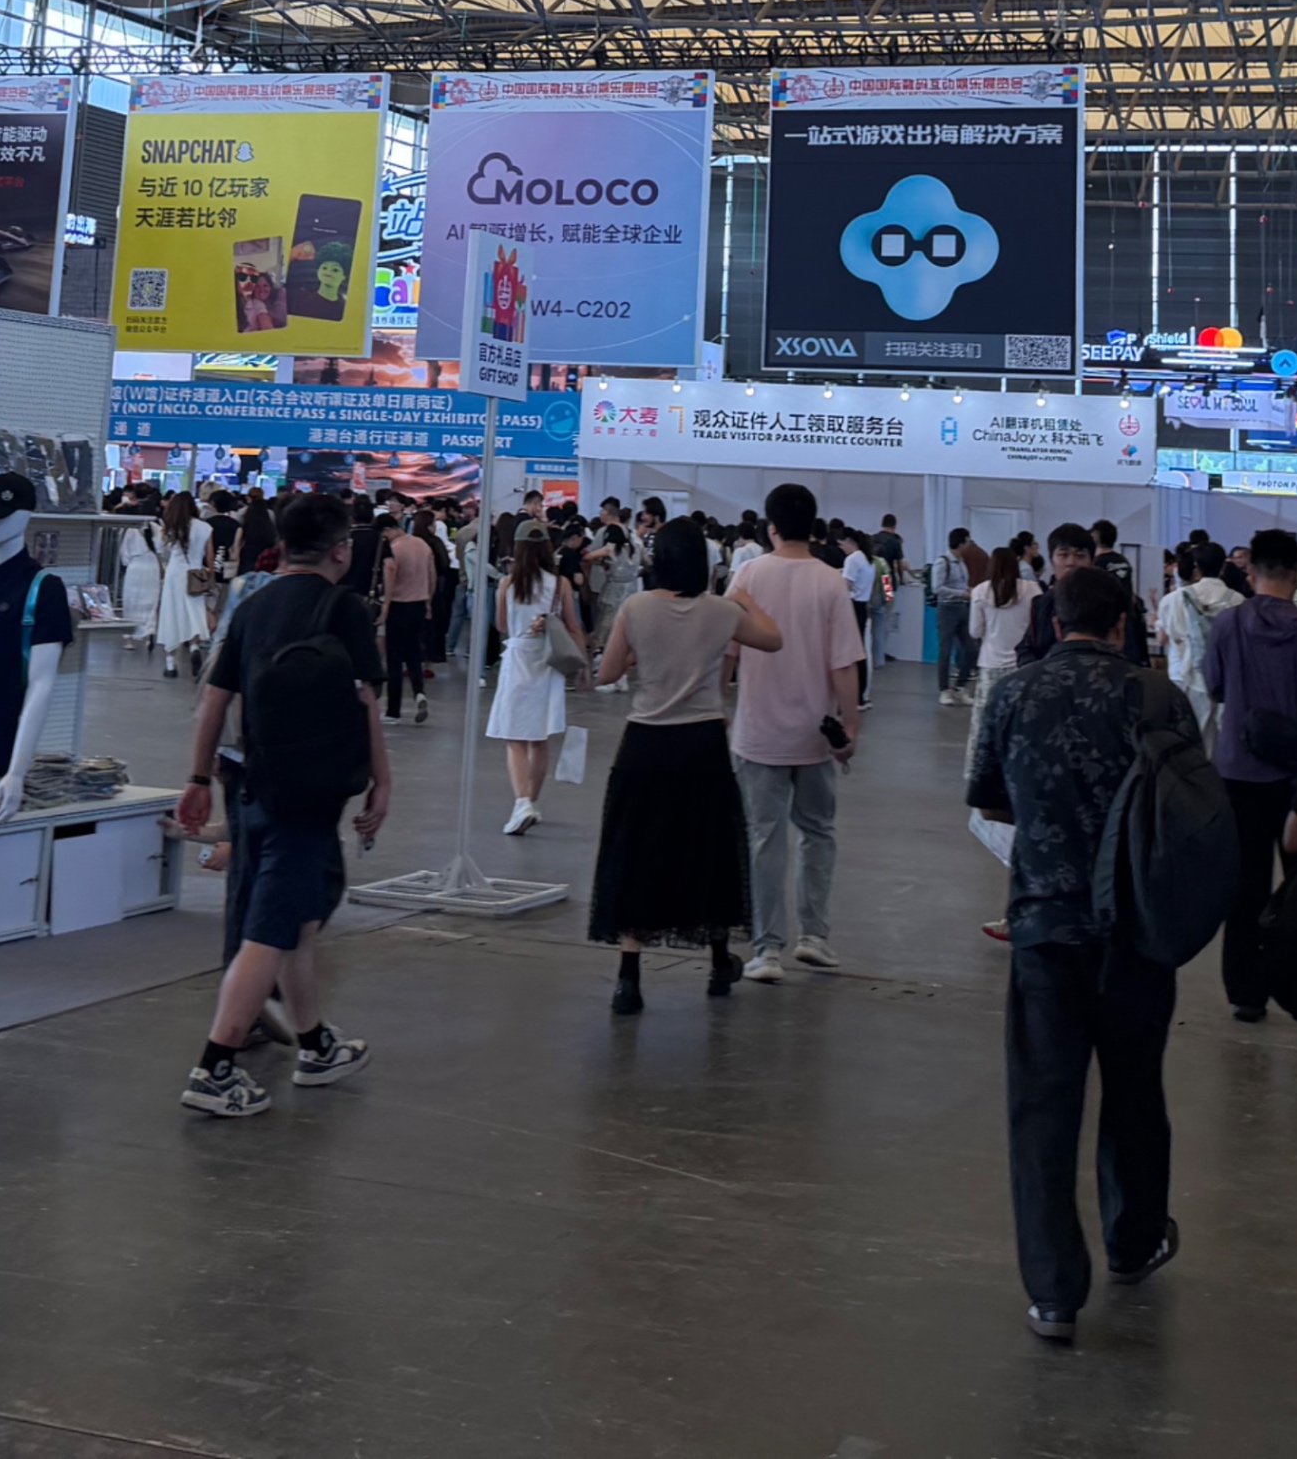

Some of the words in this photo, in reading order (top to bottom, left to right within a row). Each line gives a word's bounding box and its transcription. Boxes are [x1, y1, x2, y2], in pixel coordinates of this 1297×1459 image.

[784, 124, 1064, 146] 一站式游戏出海解决方案
[141, 140, 237, 164] SNAPCHAT
[137, 177, 178, 198] 与近
[183, 179, 203, 197] 10
[208, 178, 270, 199] 亿玩家
[494, 178, 659, 206] MOLOCO
[135, 207, 237, 229] 天涯若比邻
[446, 224, 466, 241] AI
[479, 342, 522, 369] 官方礼品店
[884, 341, 982, 359] 扫码关注我们
[479, 366, 497, 384] GIFT
[497, 370, 519, 387] SHOP
[122, 402, 155, 415] (NOT
[158, 404, 202, 416] INCLD.
[205, 405, 291, 418] CONFERENCE
[293, 408, 326, 420] PASS
[329, 411, 336, 419] &
[339, 409, 421, 423] SINGLE-DAY
[424, 412, 500, 426] EXHIBITO
[503, 415, 543, 429] PASS)
[618, 405, 659, 425] 大麦
[693, 409, 905, 436] 观众证件人工领取服务台
[308, 428, 429, 447] 港澳台通行证通道
[441, 433, 514, 449] PASSPRT
[693, 429, 727, 440] TRADE
[730, 431, 773, 442] VISITOR
[775, 432, 801, 443] PASS
[803, 434, 848, 445] SERVICE
[850, 436, 903, 447] COUNTER
[972, 428, 1035, 446] ChinaJoy
[1051, 432, 1105, 446] 科大讯飞
